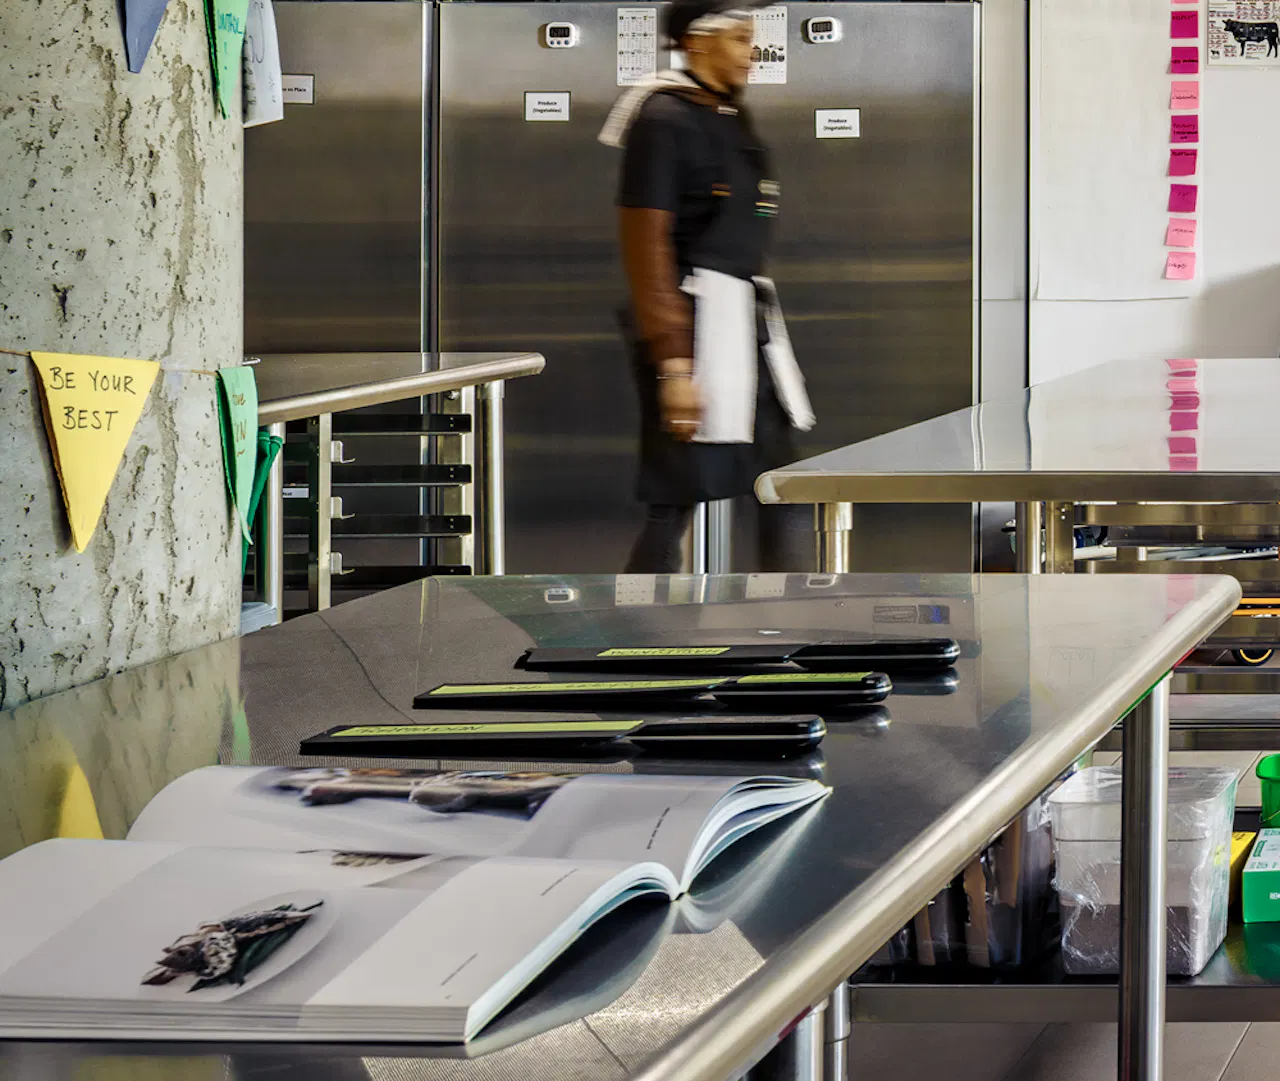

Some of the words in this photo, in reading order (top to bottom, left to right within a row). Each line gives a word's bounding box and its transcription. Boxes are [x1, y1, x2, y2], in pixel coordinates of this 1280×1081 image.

[49, 367, 75, 390] BE
[90, 370, 136, 395] YOUR
[62, 406, 119, 431] BEST
